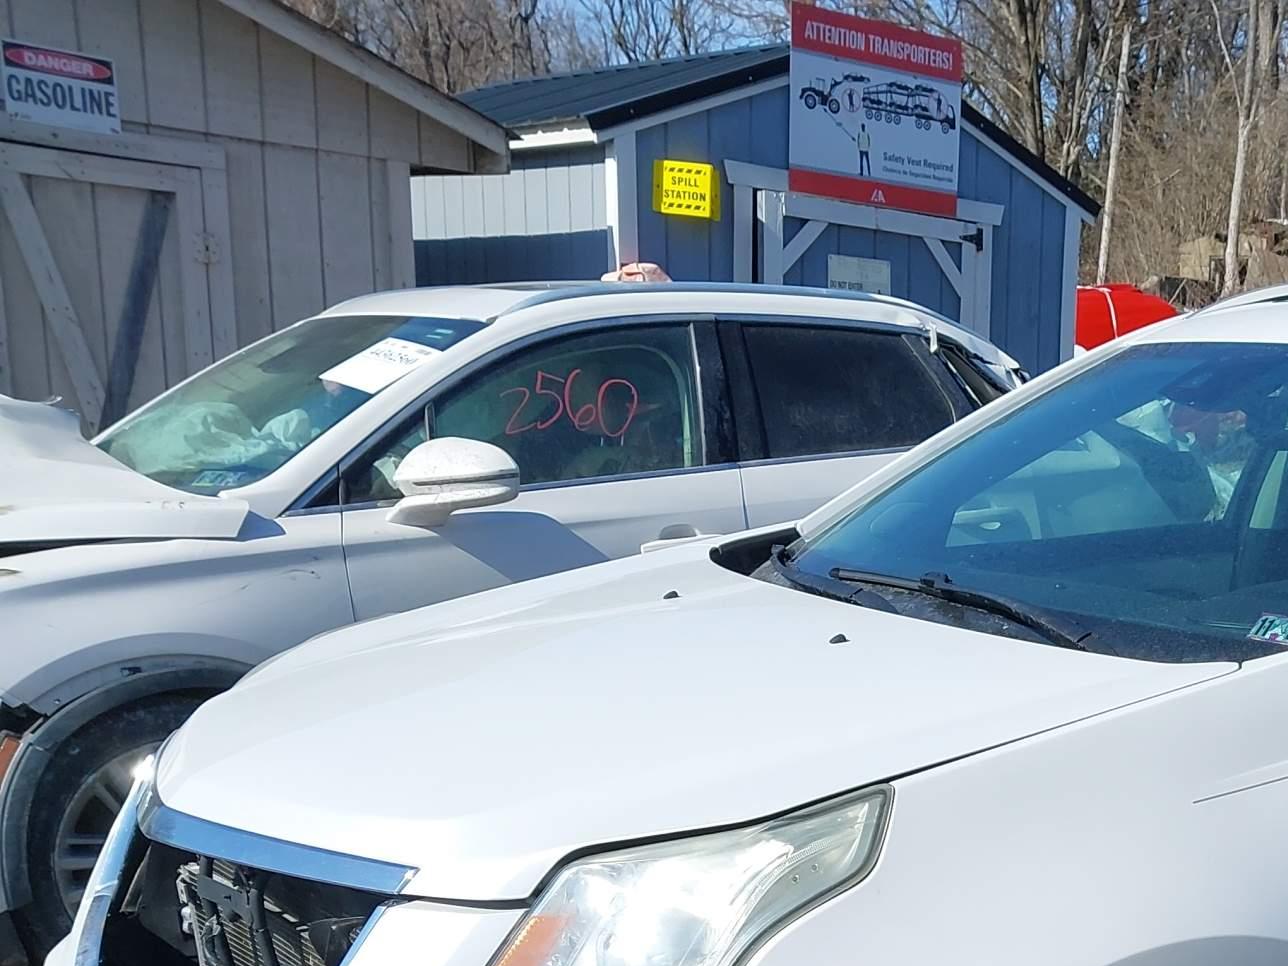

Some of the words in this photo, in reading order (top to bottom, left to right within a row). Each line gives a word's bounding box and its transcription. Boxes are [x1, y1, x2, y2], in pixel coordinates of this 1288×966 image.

[804, 20, 866, 52] ATTENTION
[868, 34, 953, 71] TRANSPORTERS!
[23, 50, 95, 76] DANGER
[7, 74, 117, 118] GASOLINE
[882, 151, 905, 166] Safety
[906, 156, 922, 168] Vest
[922, 158, 954, 173] Required
[671, 176, 699, 187] SPILL
[663, 189, 706, 202] STATION
[499, 368, 638, 438] 2560
[1254, 617, 1277, 637] 11
